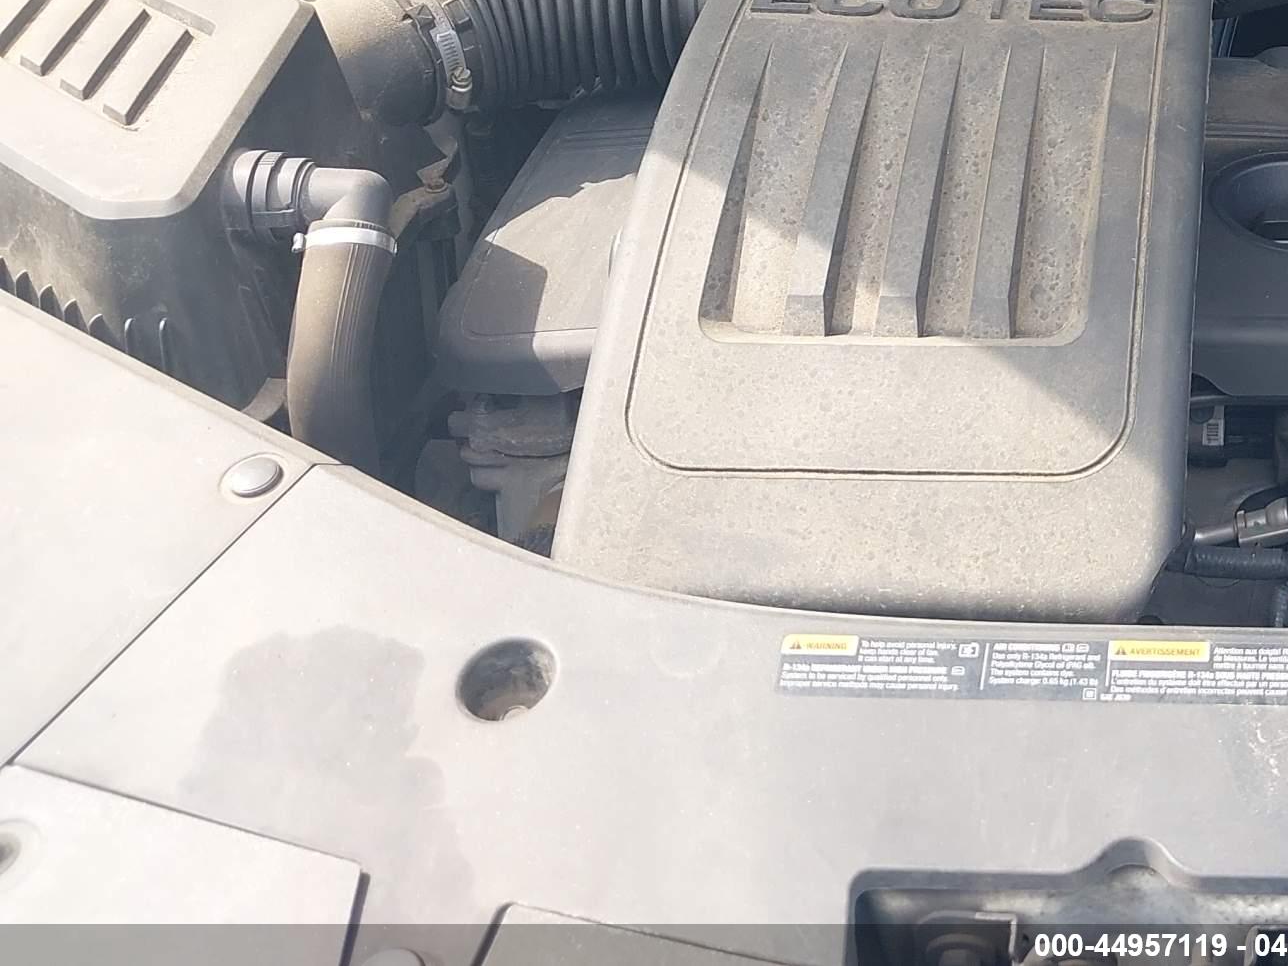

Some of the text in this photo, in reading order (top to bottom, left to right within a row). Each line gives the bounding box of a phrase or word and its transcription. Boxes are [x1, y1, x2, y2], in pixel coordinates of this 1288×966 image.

[806, 642, 847, 651] WARNING
[870, 640, 885, 649] help
[906, 641, 935, 651] personal
[1130, 648, 1200, 656] AVERTISSEMENT
